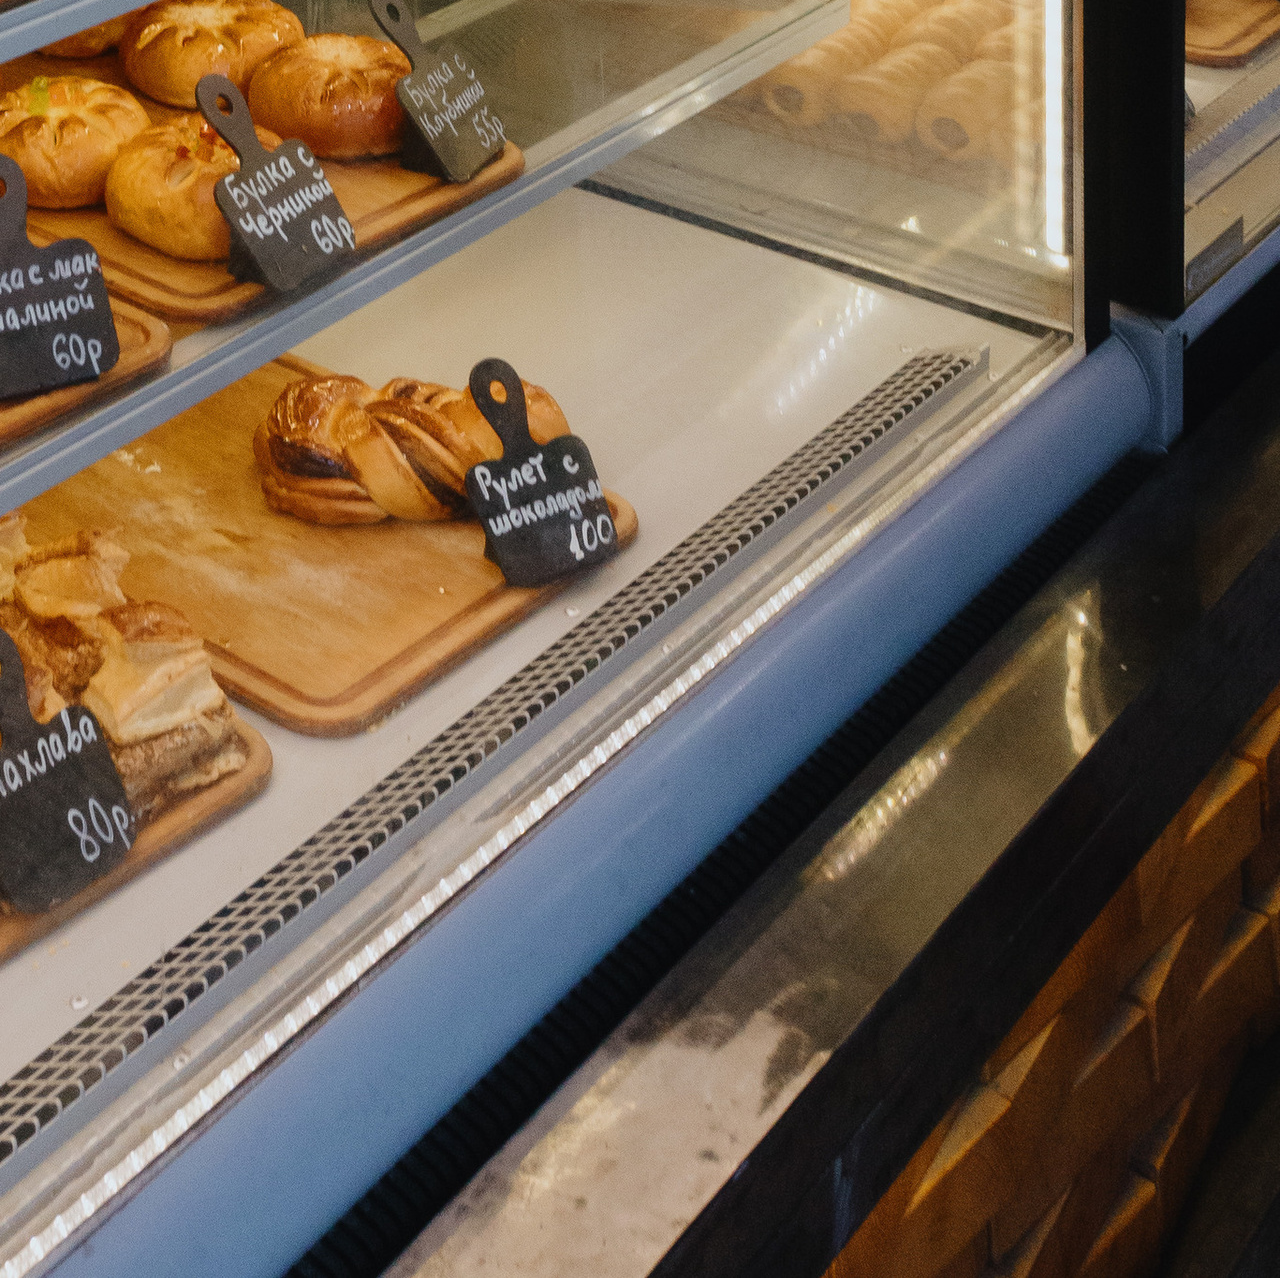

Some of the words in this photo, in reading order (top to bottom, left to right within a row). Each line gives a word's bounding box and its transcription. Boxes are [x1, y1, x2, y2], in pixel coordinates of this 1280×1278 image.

[404, 62, 454, 111] Булка
[224, 156, 296, 215] Булка
[297, 146, 314, 168] с
[238, 167, 334, 242] Черникой
[28, 264, 44, 285] с
[52, 333, 103, 375] 60р
[474, 452, 547, 511] Рулет
[562, 454, 580, 475] с
[488, 478, 605, 536] шоколадом
[569, 514, 614, 561] 100
